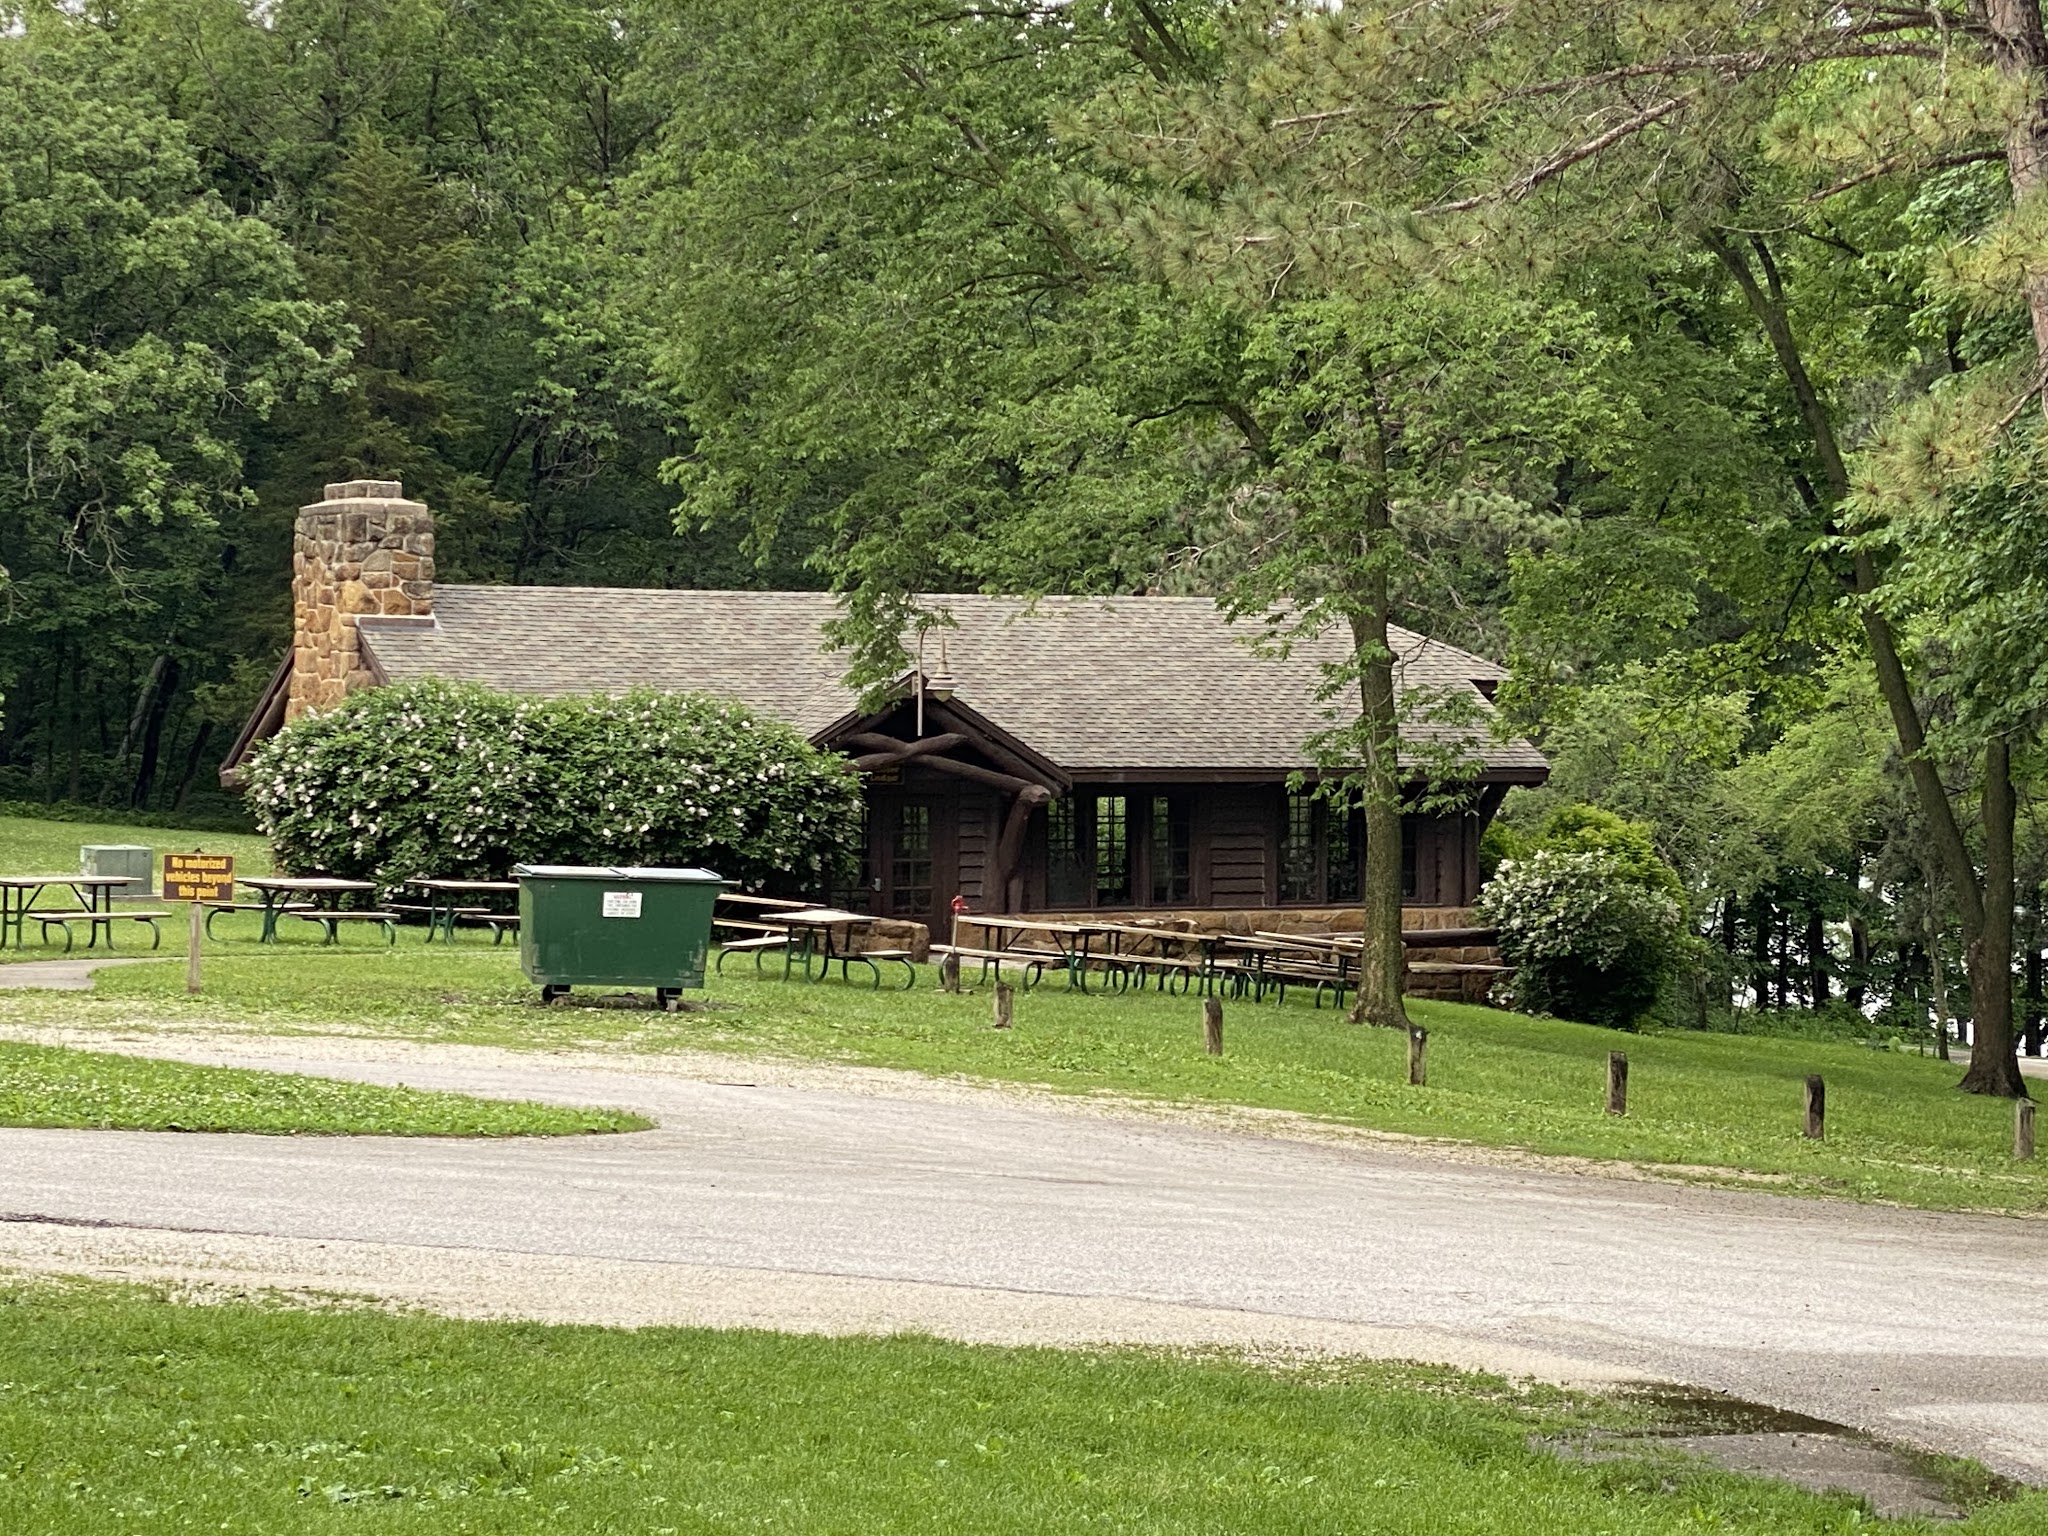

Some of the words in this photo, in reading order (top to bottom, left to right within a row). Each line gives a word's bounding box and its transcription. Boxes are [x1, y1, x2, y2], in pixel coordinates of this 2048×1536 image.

[171, 856, 183, 868] No
[185, 858, 226, 869] motorized
[165, 871, 200, 883] vehicles
[202, 872, 232, 885] beyond
[178, 885, 195, 896] this
[196, 886, 218, 900] point
